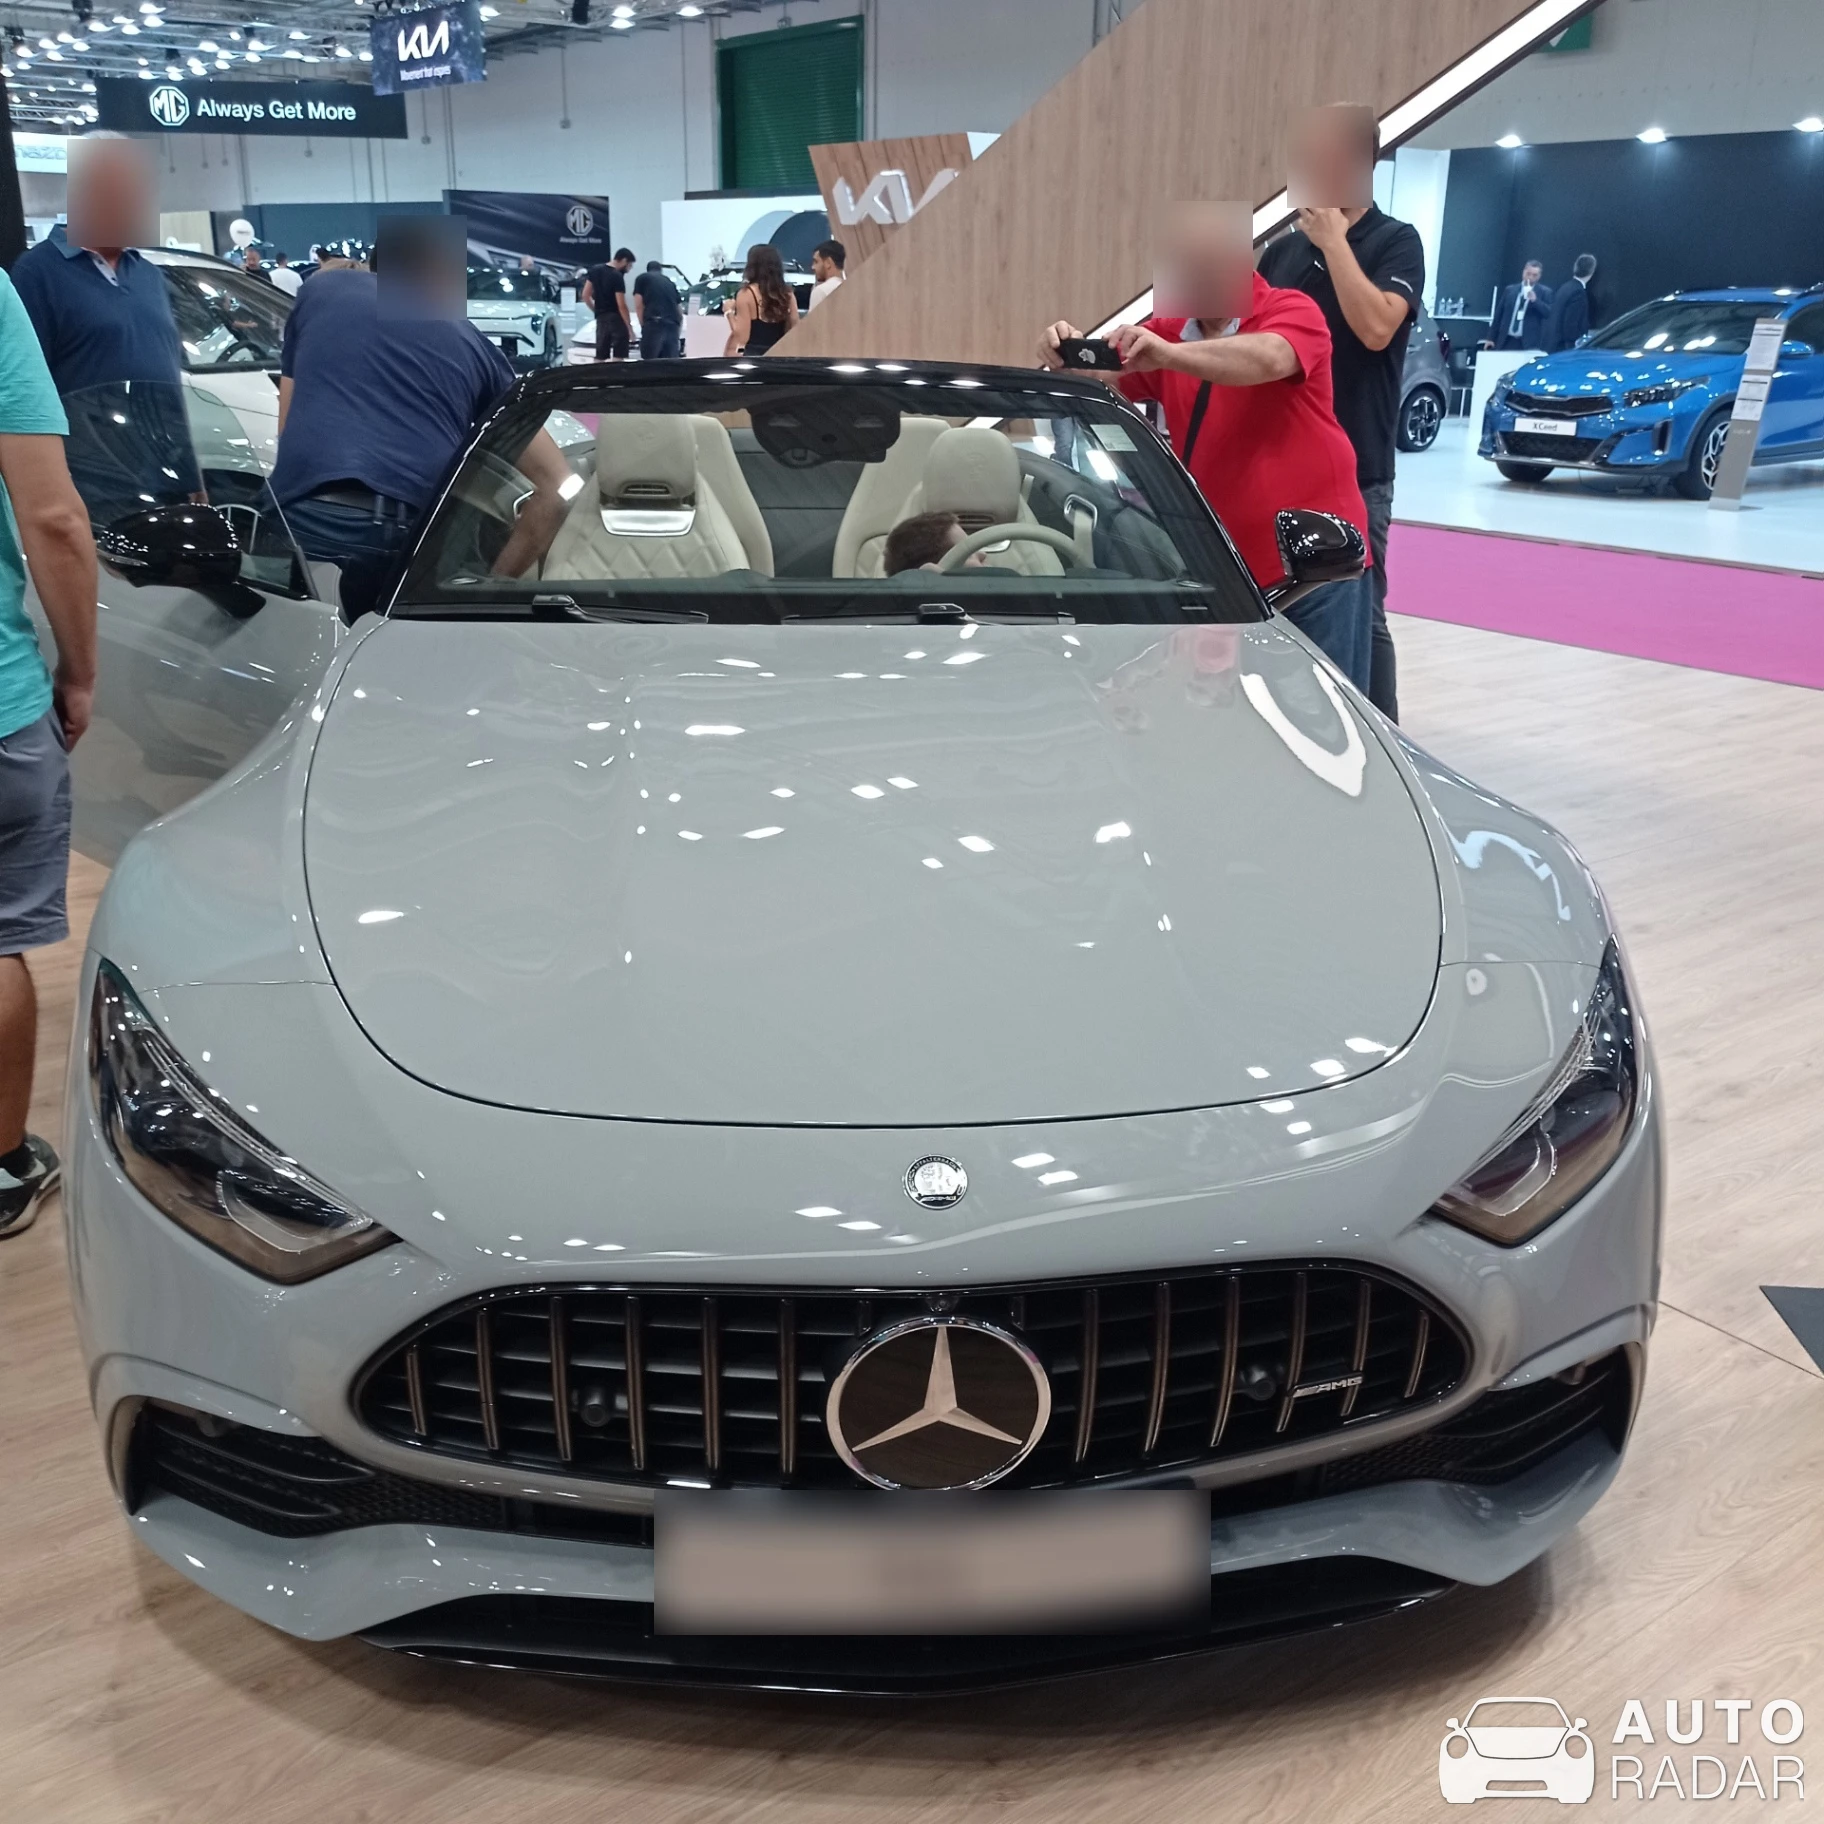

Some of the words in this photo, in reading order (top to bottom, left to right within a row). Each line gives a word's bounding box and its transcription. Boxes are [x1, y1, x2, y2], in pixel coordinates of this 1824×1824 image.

[153, 89, 186, 122] MG
[197, 99, 265, 122] Always
[269, 101, 303, 119] Get
[308, 101, 356, 120] More
[569, 208, 591, 233] MG
